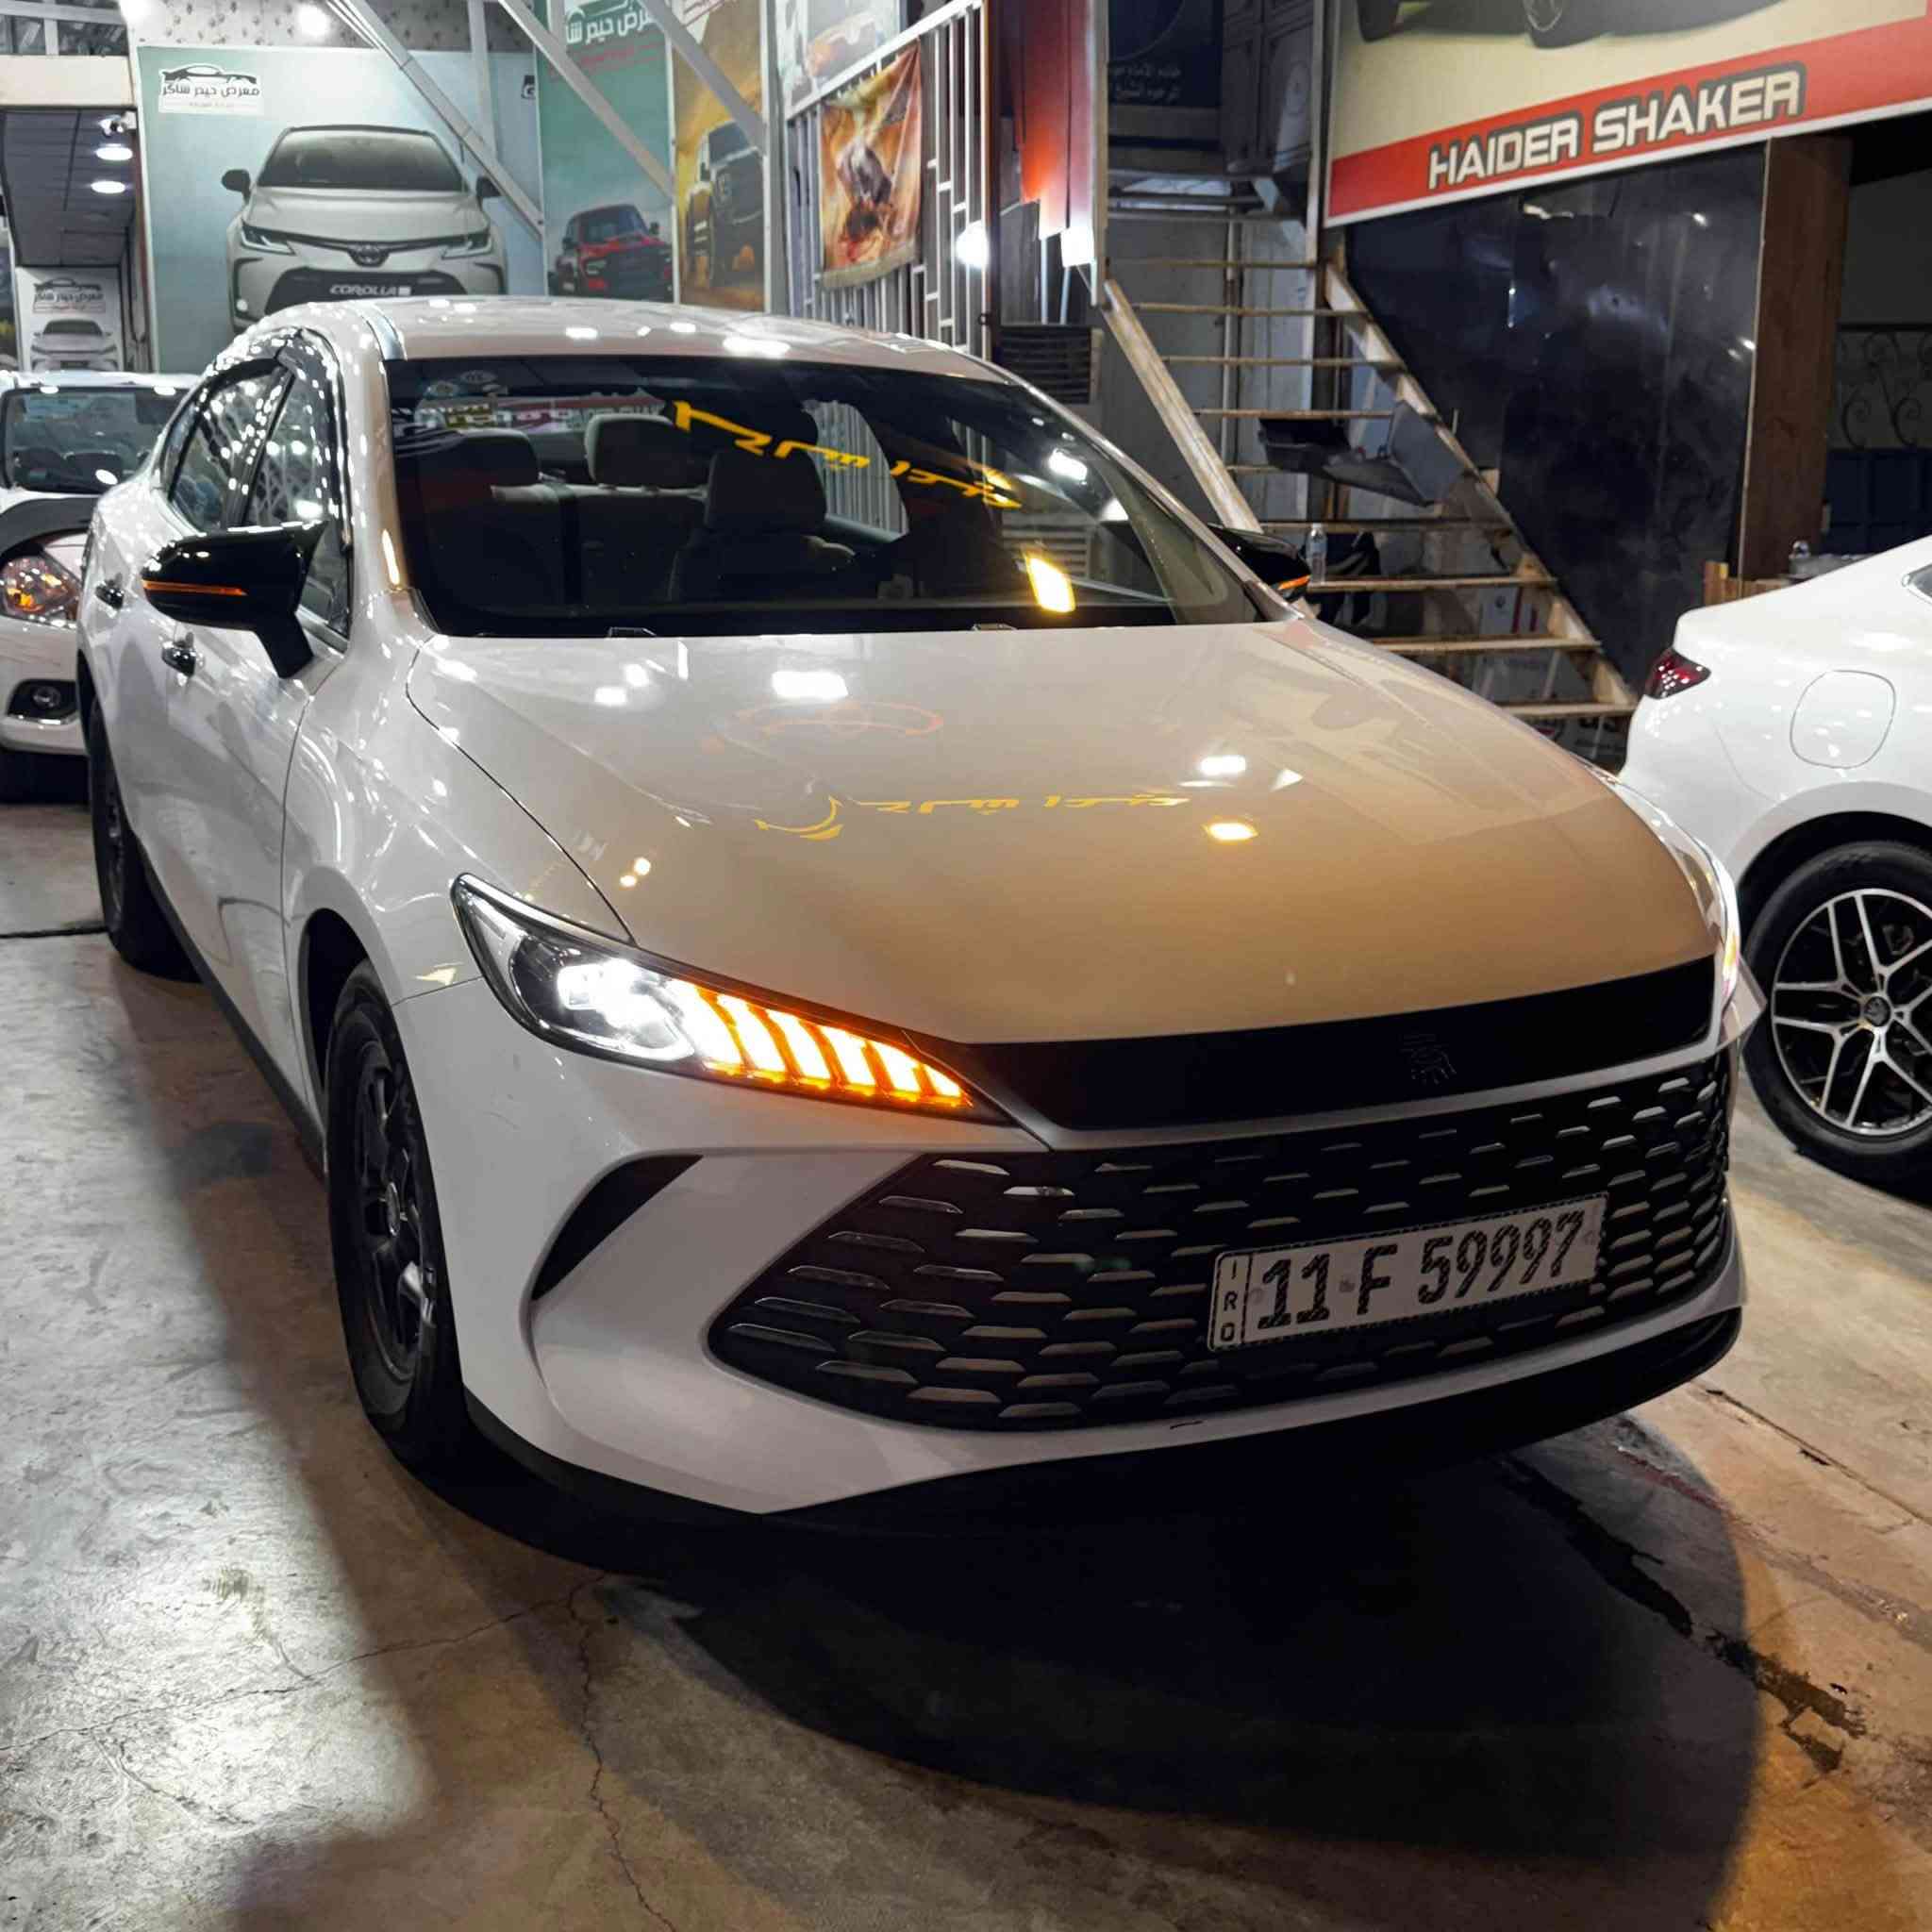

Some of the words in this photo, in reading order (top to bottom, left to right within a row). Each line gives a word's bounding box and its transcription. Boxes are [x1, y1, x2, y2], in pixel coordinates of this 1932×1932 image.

[1427, 116, 1580, 191] HAIDER
[1591, 68, 1802, 155] SHAKER
[329, 285, 396, 296] COROLLA
[1257, 1254, 1330, 1329] 11
[1357, 1243, 1397, 1315] F
[1418, 1209, 1586, 1306] 59997
